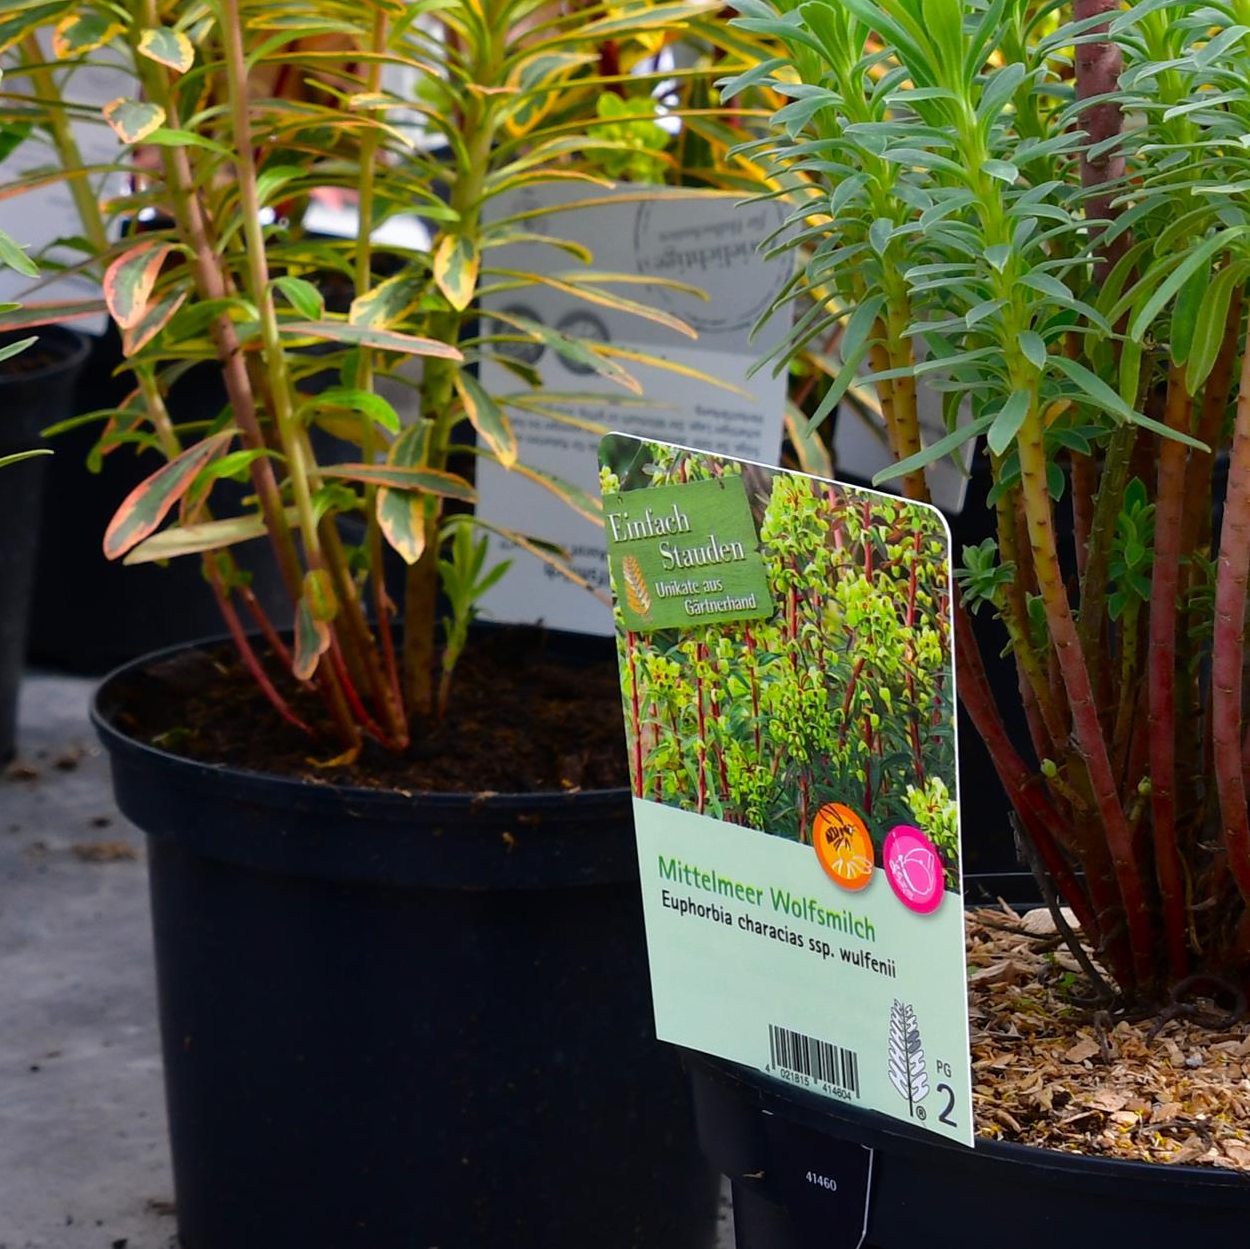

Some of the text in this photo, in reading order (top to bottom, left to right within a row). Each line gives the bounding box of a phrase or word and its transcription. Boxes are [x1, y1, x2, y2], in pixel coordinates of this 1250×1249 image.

[608, 504, 692, 543] Einfach
[658, 535, 747, 571] Stauden
[655, 578, 724, 598] Unikate aus
[684, 593, 757, 615] Gärtnerhand
[658, 855, 876, 943] Mittelmeer Wolfsmilch
[662, 889, 897, 978] Euphorbia characias ssp. wulfenii
[780, 1069, 810, 1087] 021815
[822, 1083, 852, 1100] 414604
[936, 1059, 952, 1078] PG
[936, 1083, 958, 1128] 2
[805, 1170, 837, 1192] 41460
